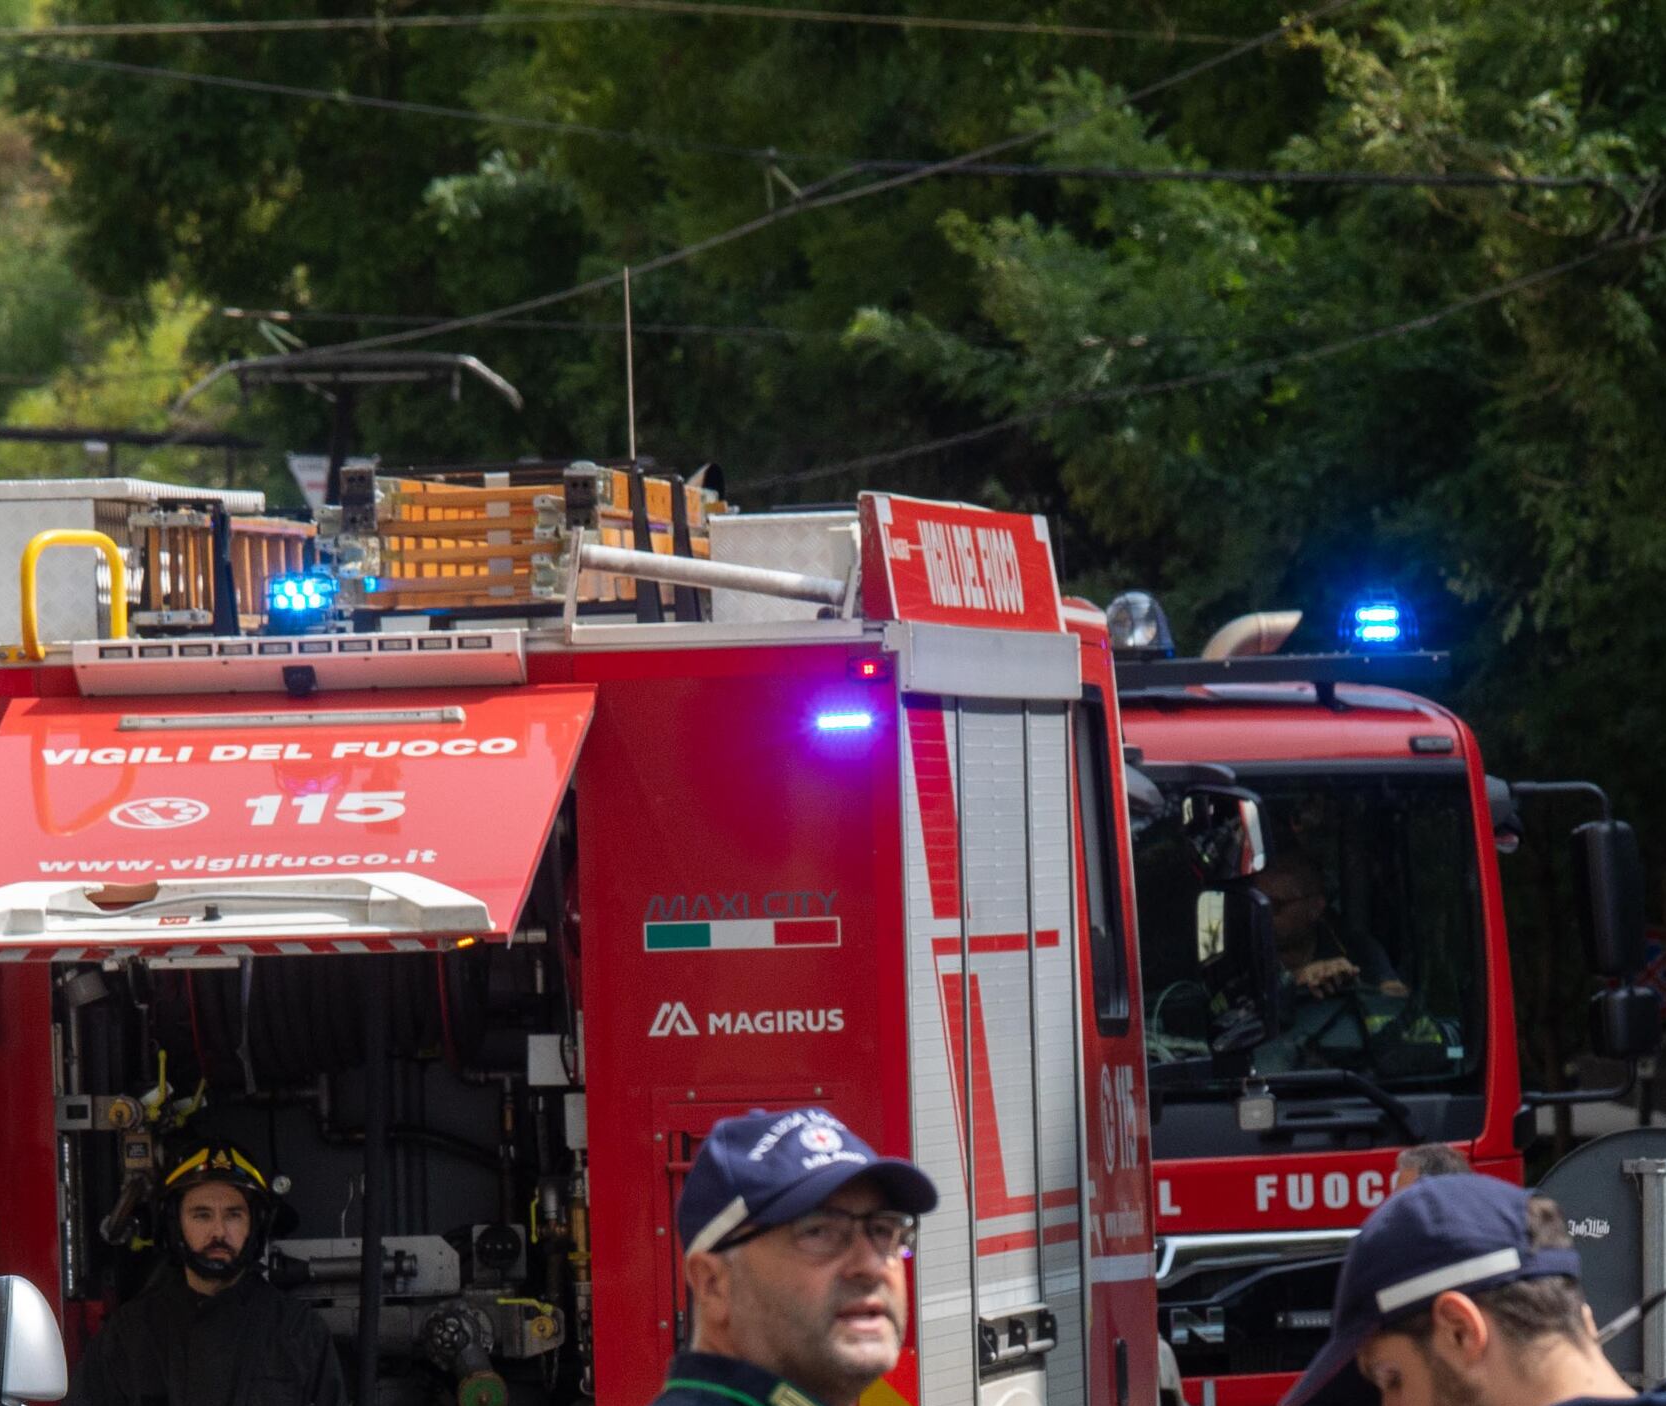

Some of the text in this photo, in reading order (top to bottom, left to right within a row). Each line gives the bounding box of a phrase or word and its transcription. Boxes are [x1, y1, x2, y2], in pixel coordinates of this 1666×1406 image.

[41, 736, 517, 766] VIGILI DEL FUOCO
[245, 790, 407, 826] 115
[39, 847, 438, 873] www.vigilfuoco.it
[645, 891, 838, 921] MAXI CITY
[708, 1008, 845, 1035] MAGIRUS
[1254, 1169, 1399, 1213] FUOC
